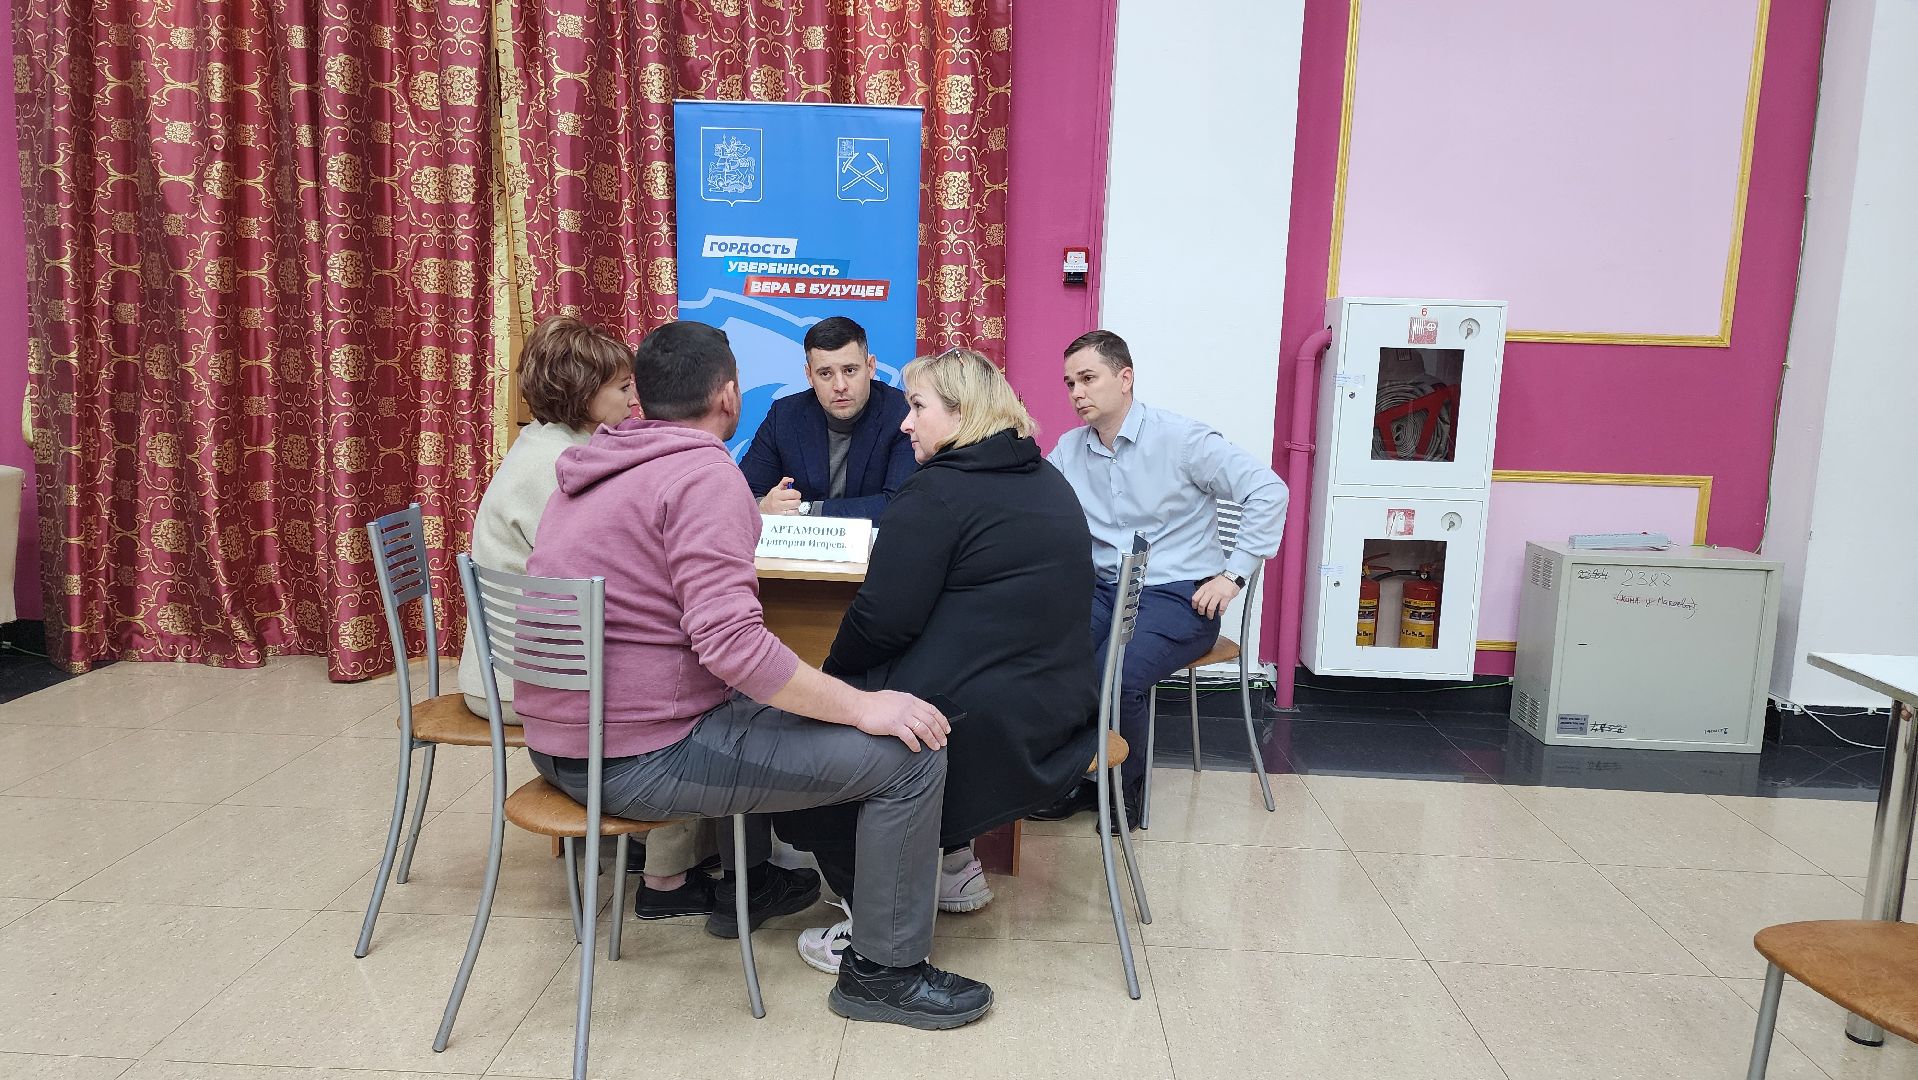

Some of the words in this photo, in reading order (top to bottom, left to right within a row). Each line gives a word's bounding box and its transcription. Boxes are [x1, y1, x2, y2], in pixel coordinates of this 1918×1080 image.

[709, 241, 791, 255] ГОРДОСТЬ
[727, 260, 840, 276] УВЕРЕННОСТЬ
[750, 281, 791, 294] ВЕРА
[795, 283, 807, 294] В
[809, 283, 885, 297] БУДУЩЕЕ
[1421, 308, 1428, 316] 6
[770, 524, 847, 537] АРТАМОНОВ
